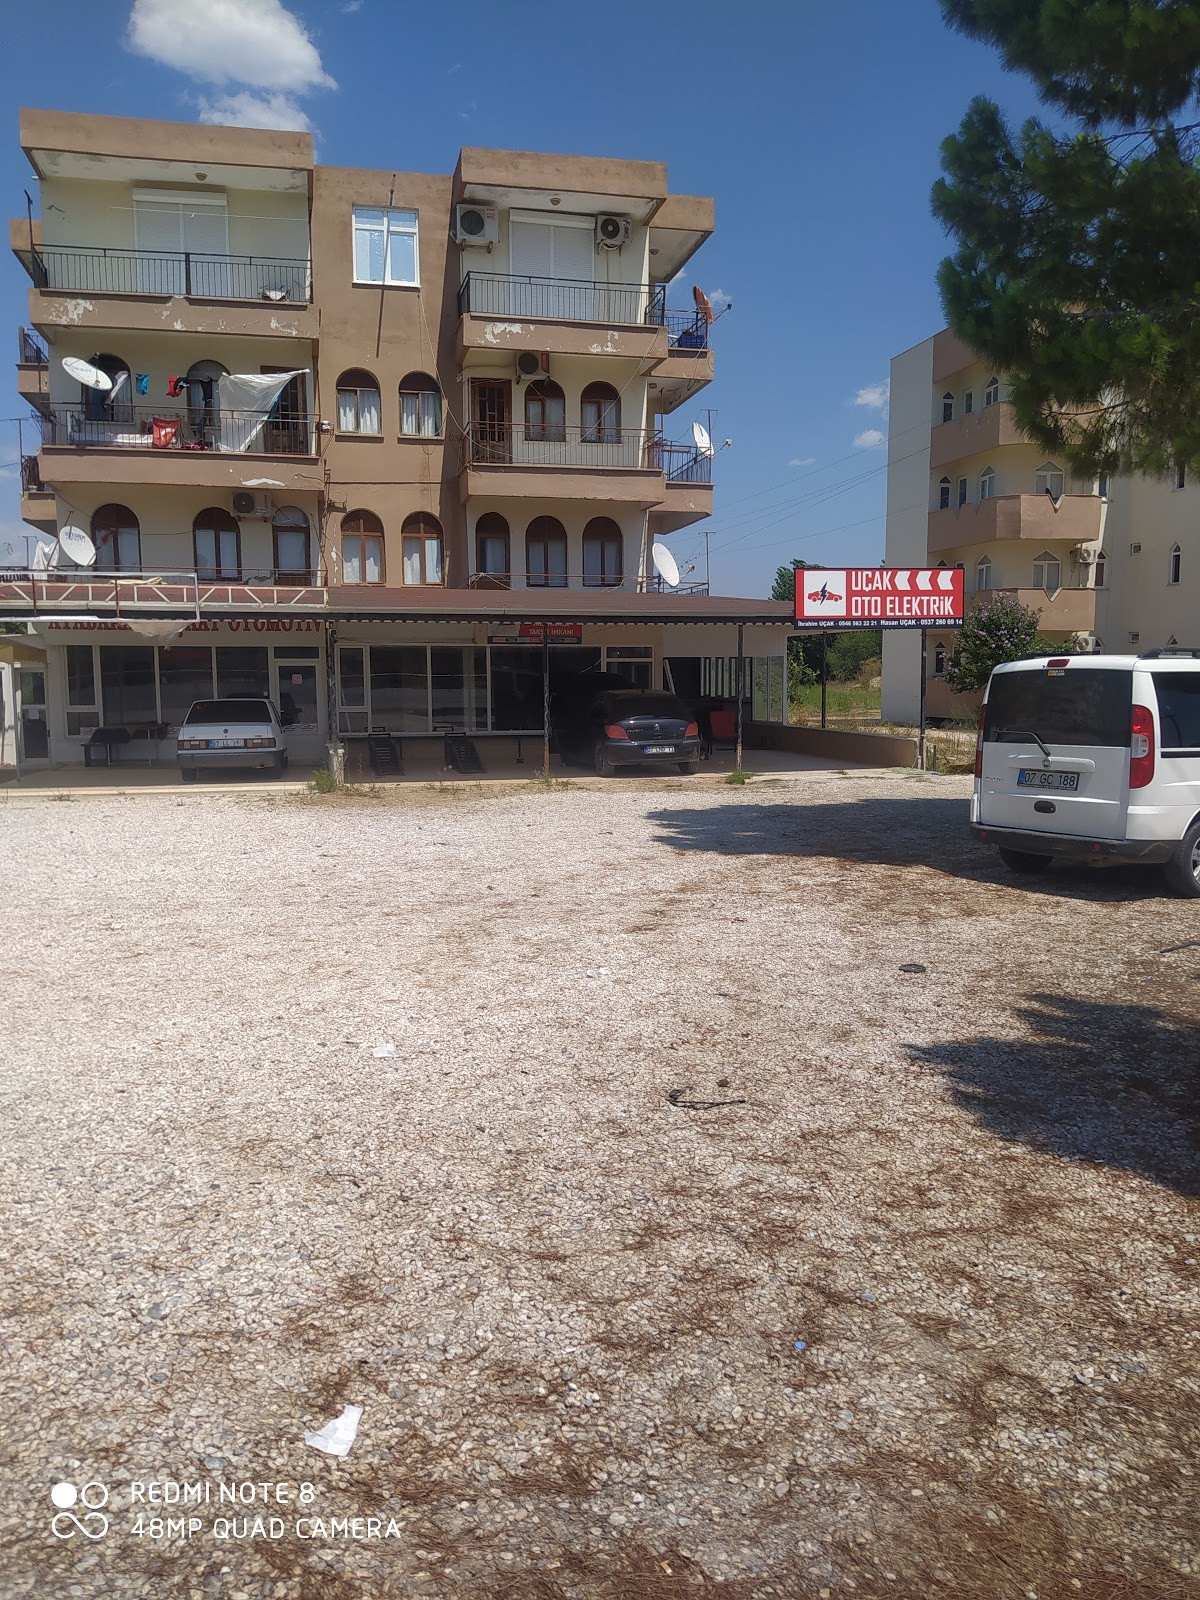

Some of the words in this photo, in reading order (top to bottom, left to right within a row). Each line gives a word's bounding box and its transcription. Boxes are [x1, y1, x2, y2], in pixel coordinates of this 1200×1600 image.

[851, 570, 893, 592] UÇAK
[851, 596, 881, 617] OTO
[899, 619, 916, 628] UÇAK
[1024, 772, 1037, 783] 07
[1039, 773, 1054, 785] GC
[1058, 774, 1076, 786] 188
